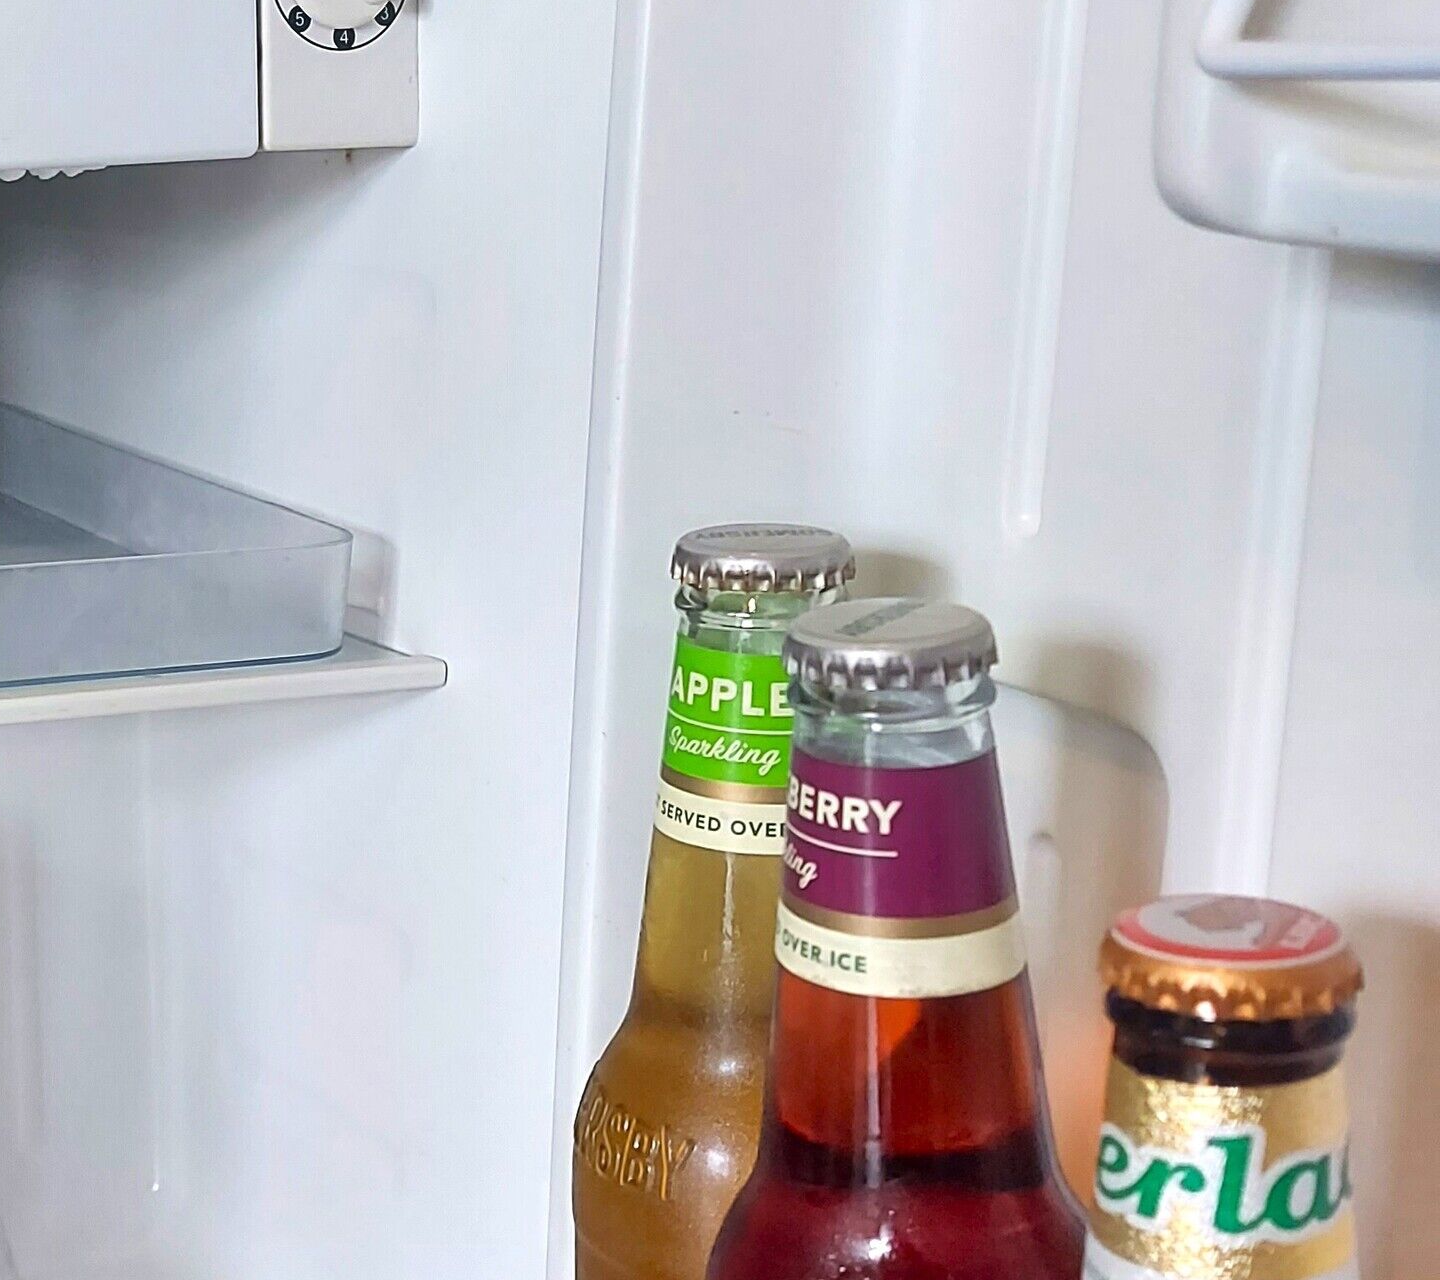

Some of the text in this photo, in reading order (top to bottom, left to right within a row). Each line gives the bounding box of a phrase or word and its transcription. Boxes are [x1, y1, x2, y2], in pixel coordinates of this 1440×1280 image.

[295, 11, 305, 28] 5
[339, 29, 349, 45] 4
[671, 669, 794, 718] APPLE
[668, 726, 782, 776] Sparkling
[661, 799, 722, 833] SERVED
[782, 928, 867, 974] OVER ICE
